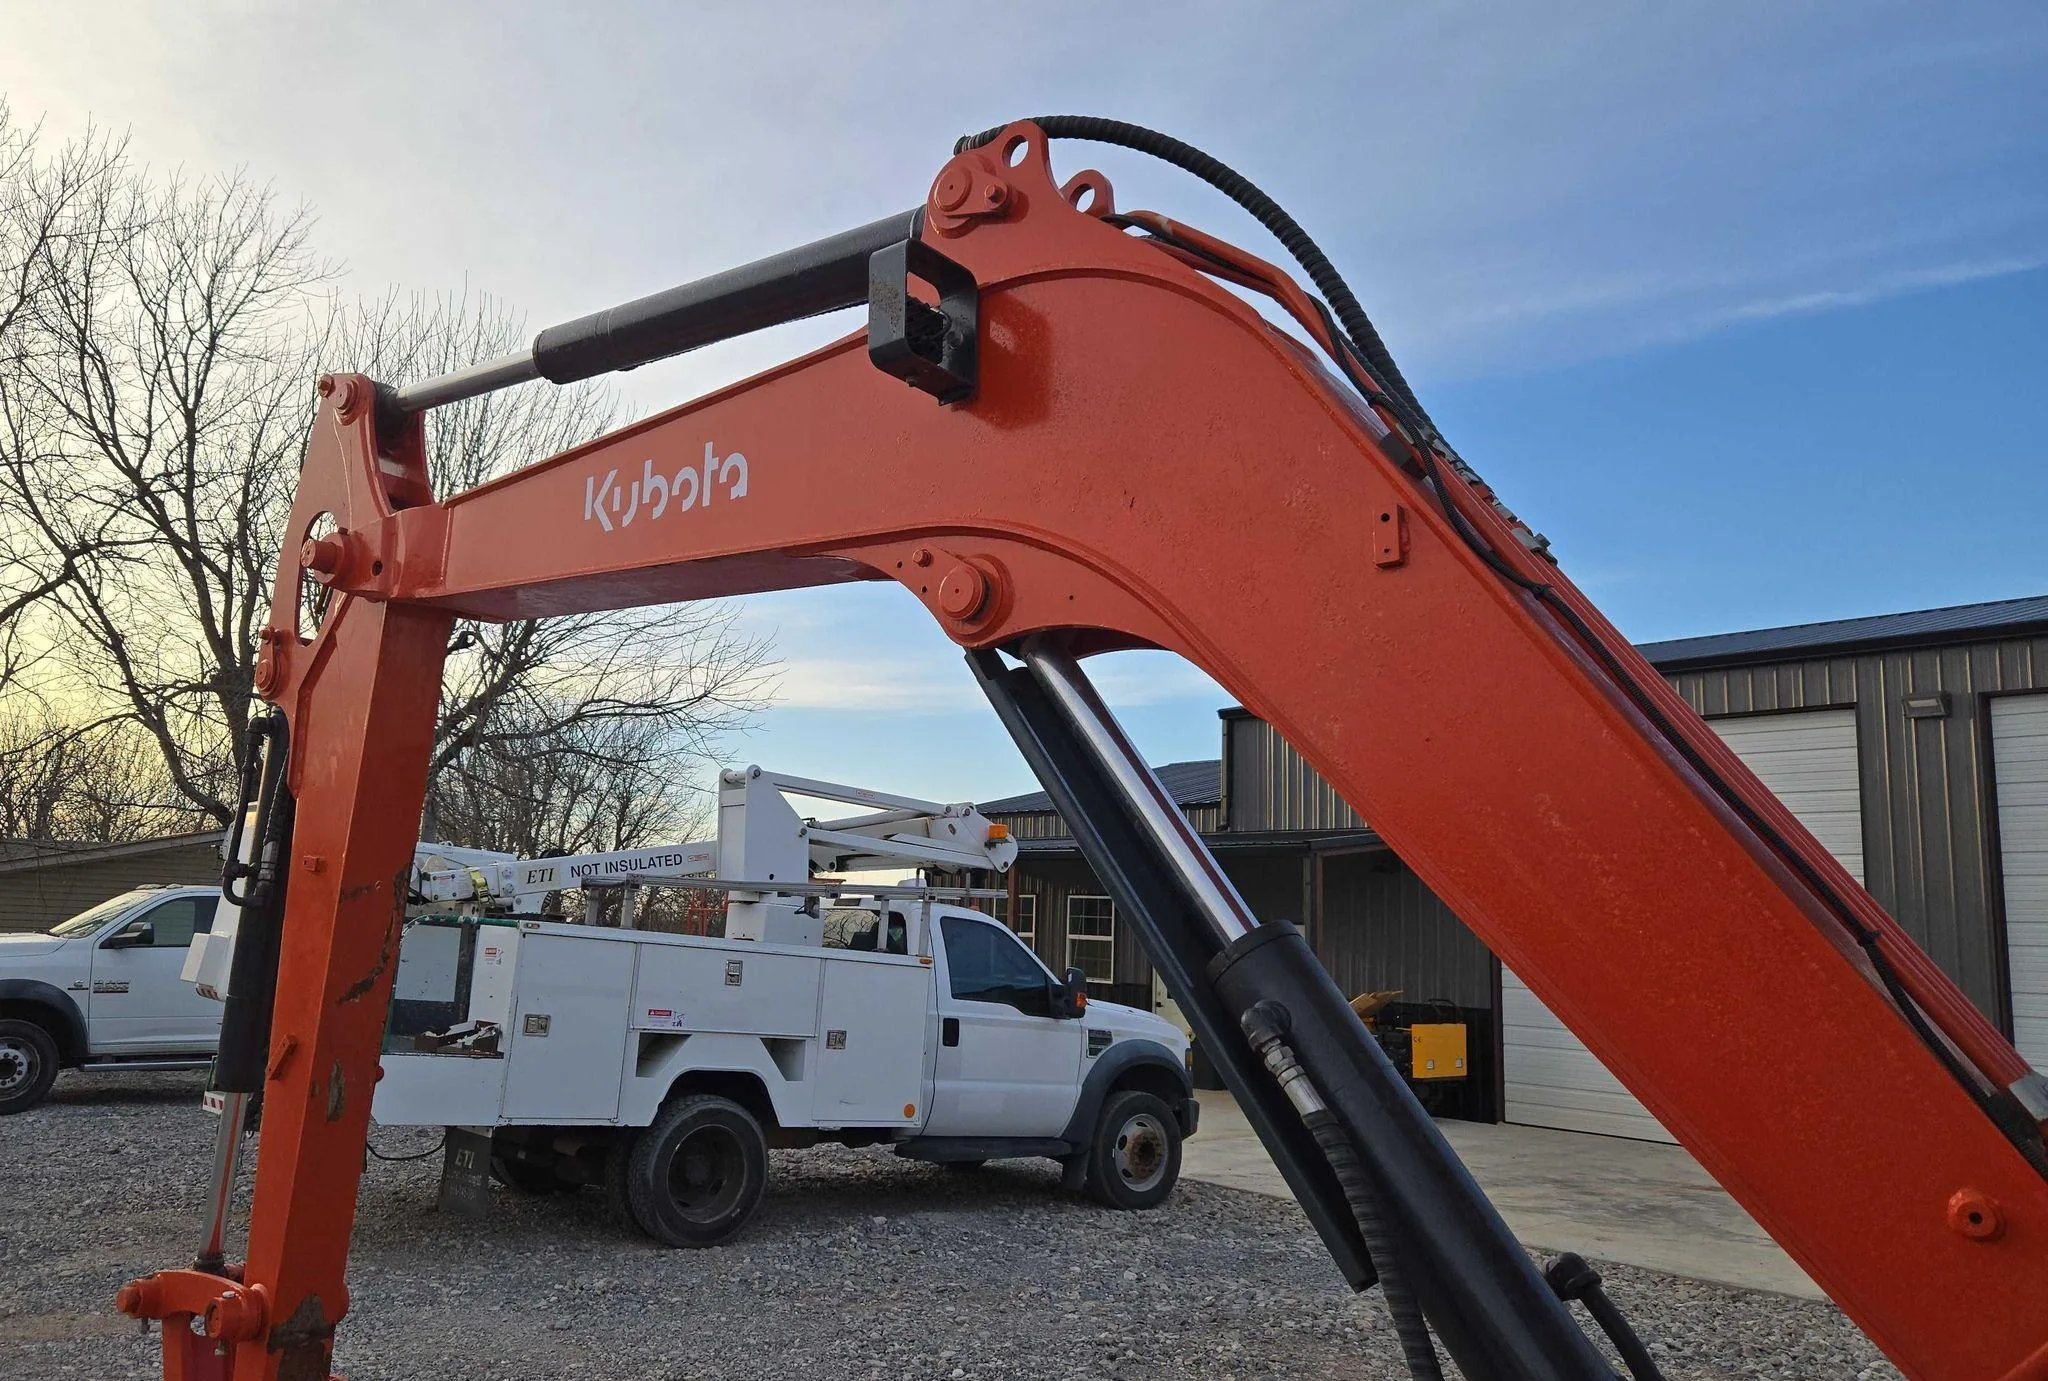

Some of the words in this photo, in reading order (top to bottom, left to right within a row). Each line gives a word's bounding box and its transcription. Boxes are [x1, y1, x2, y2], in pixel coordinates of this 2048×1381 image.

[584, 441, 748, 532] Kubota
[526, 867, 555, 885] ETI
[570, 863, 601, 878] NOT
[605, 853, 683, 874] INSULATED
